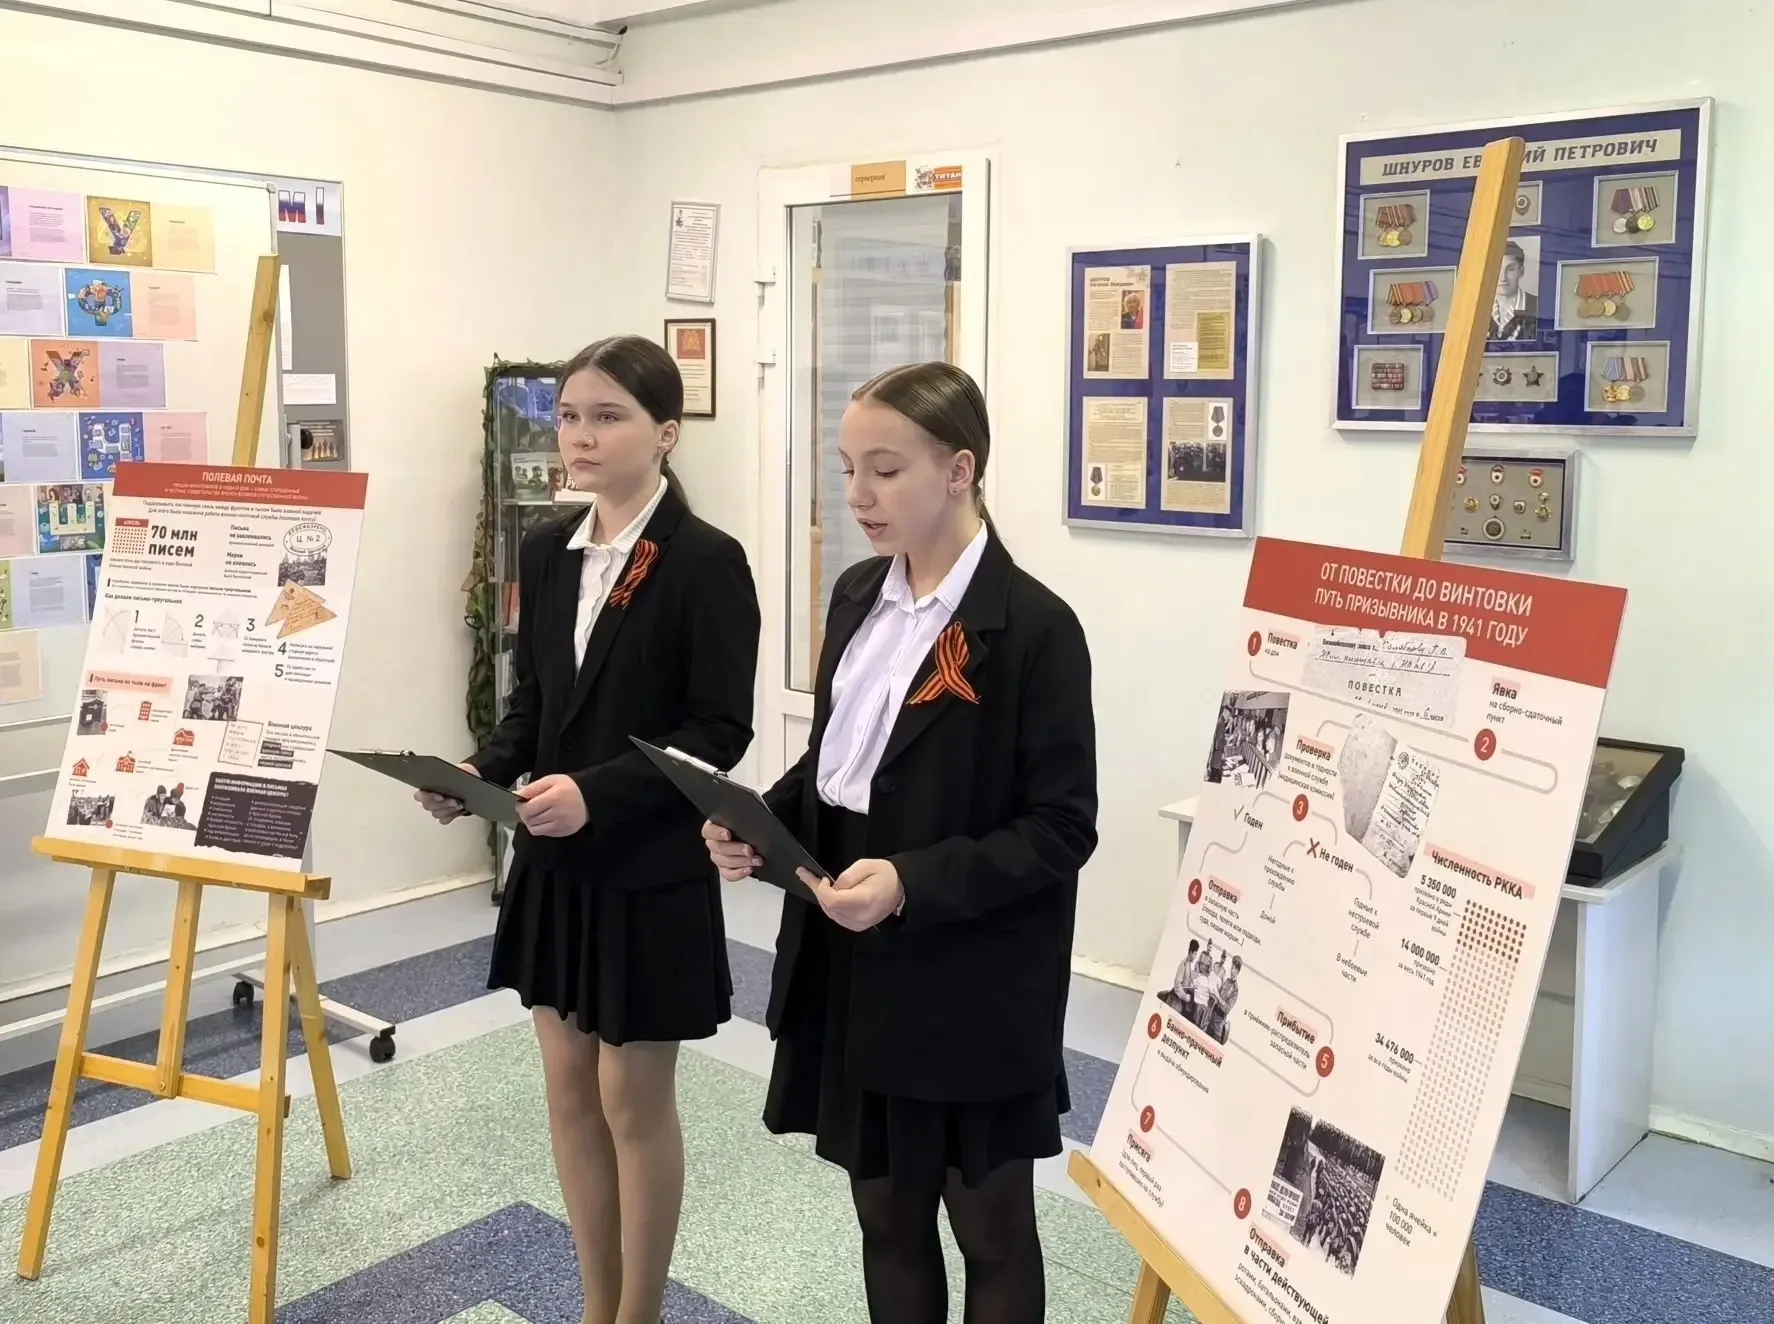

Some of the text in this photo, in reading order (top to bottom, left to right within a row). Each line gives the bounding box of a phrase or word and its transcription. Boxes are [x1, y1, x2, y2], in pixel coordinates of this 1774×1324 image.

[1382, 138, 1659, 177] ШНУРОВ ЕВИЙ ПЕТРОВИЧ
[935, 172, 962, 182] ТИТАН
[202, 471, 272, 486] ПОЛЕВАЯ ПОЧТА
[151, 525, 198, 541] 70 млн
[148, 543, 195, 557] писем
[1321, 562, 1533, 616] ОТ ПОВЕСТКИ ДО ВИНТОВКИ
[134, 610, 140, 623] 1
[194, 614, 204, 628] 2
[246, 618, 256, 632] 3
[1314, 588, 1528, 648] ПУТЬ ПРИЗЫВНИКА В 1941 ГОДУ
[277, 642, 287, 655] 4
[1267, 633, 1298, 650] Повестка
[274, 664, 284, 677] 5
[1347, 680, 1402, 697] ПОВЕСТКА
[1492, 682, 1517, 699] Явка
[1486, 713, 1505, 724] пункт
[1489, 700, 1562, 726] на сборно-сдаточный
[1296, 739, 1332, 762] Проверка
[1481, 737, 1490, 753] 2
[1284, 752, 1338, 778] документов годности
[1292, 767, 1311, 780] военной
[1312, 773, 1329, 787] службе
[1296, 800, 1304, 815] 3
[1244, 812, 1264, 831] Годен
[1319, 847, 1354, 873] Не годен
[1264, 865, 1296, 886] прохождению
[1431, 850, 1523, 900] Численность РККА
[1191, 886, 1198, 899] 4
[1208, 879, 1238, 905] Отправка
[1267, 878, 1285, 893] службы
[1414, 886, 1436, 901] призвано
[1420, 874, 1457, 900] 5 350 000
[1353, 897, 1374, 914] Годные
[1416, 896, 1436, 910] Красной
[1259, 910, 1276, 925] Домой
[1348, 909, 1380, 931] нестроевой
[1350, 923, 1371, 939] службе
[1431, 925, 1447, 937] войны
[1401, 938, 1440, 967] 14 000 000
[1341, 957, 1368, 977] небоевые
[1413, 959, 1436, 976] призвано
[1341, 969, 1357, 983] части
[1151, 1019, 1157, 1033] 6
[1276, 1011, 1316, 1044] Прибытие
[1161, 1033, 1190, 1060] дезпункт
[1166, 1018, 1223, 1068] Банно-прачечный
[1375, 1033, 1414, 1065] 34 476 000
[1269, 1039, 1307, 1071] запасной части
[1320, 1054, 1329, 1069] 5
[1389, 1056, 1411, 1074] призвано
[1144, 1112, 1152, 1126] 7
[1126, 1134, 1151, 1163] Присяга
[1238, 1196, 1246, 1212] 8
[1389, 1210, 1413, 1235] 100 000
[1392, 1197, 1432, 1234] Одна ячейка
[1385, 1222, 1411, 1247] человек
[1249, 1227, 1286, 1269] Отправка
[1237, 1262, 1292, 1319] ротами, батальонами,
[1244, 1244, 1330, 1324] в части действующей
